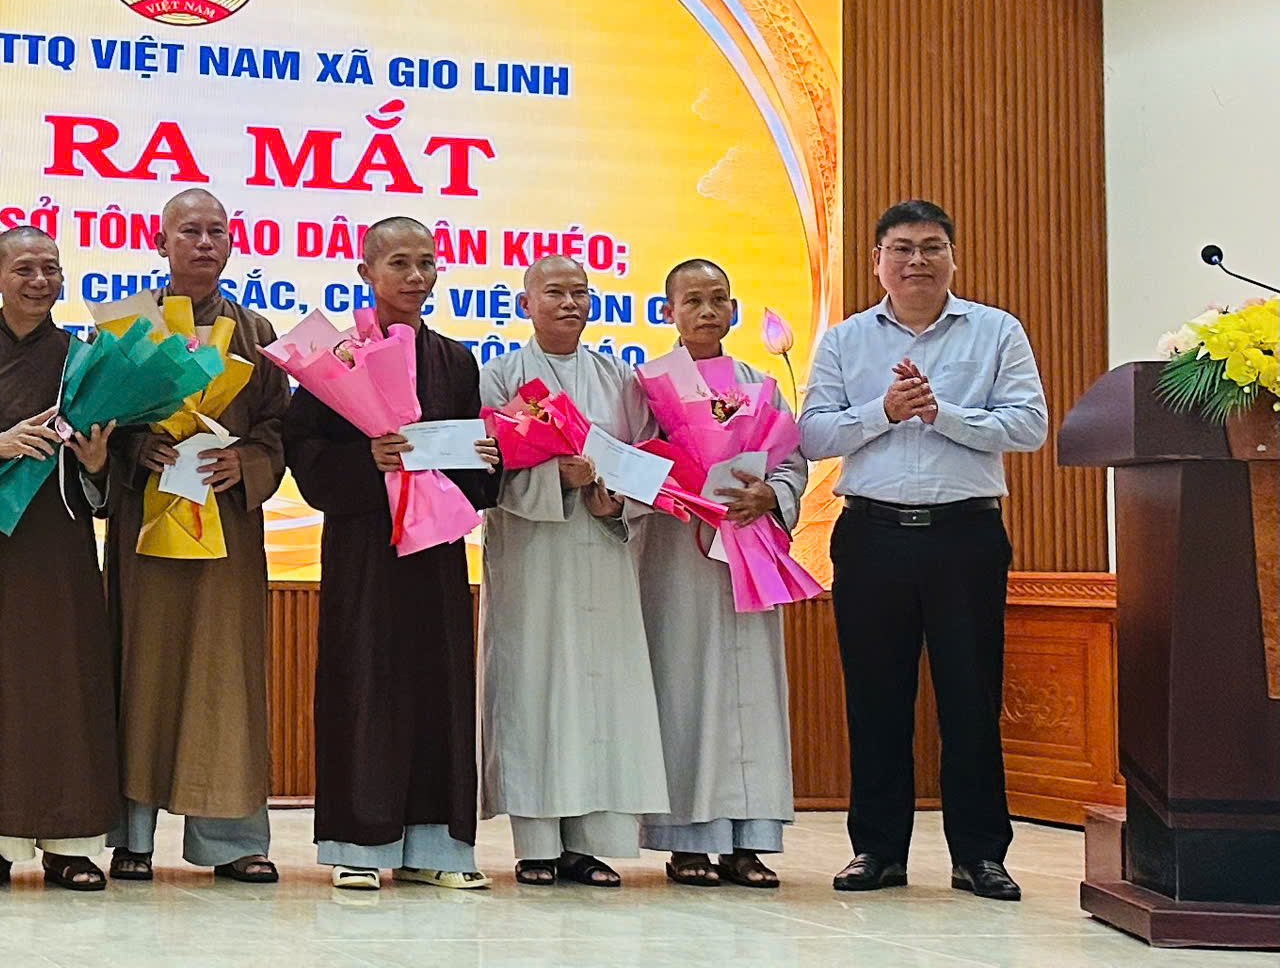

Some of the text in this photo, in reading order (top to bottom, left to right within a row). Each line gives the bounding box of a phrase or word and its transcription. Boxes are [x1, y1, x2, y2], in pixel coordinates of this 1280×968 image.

[184, 1, 216, 18] NAM
[92, 35, 184, 79] VIỆT
[199, 45, 300, 81] NAM
[316, 49, 373, 85] XÃ
[389, 57, 458, 90] GIO
[474, 62, 569, 96] LINH
[43, 114, 210, 183] RA
[246, 98, 496, 197] MẮT
[0, 196, 60, 241] SỞ
[73, 204, 162, 251] TÔN
[228, 210, 280, 256] ÁO
[432, 220, 487, 271] ẬN
[503, 226, 626, 276] KHÉO;
[218, 268, 308, 314] SẮC,
